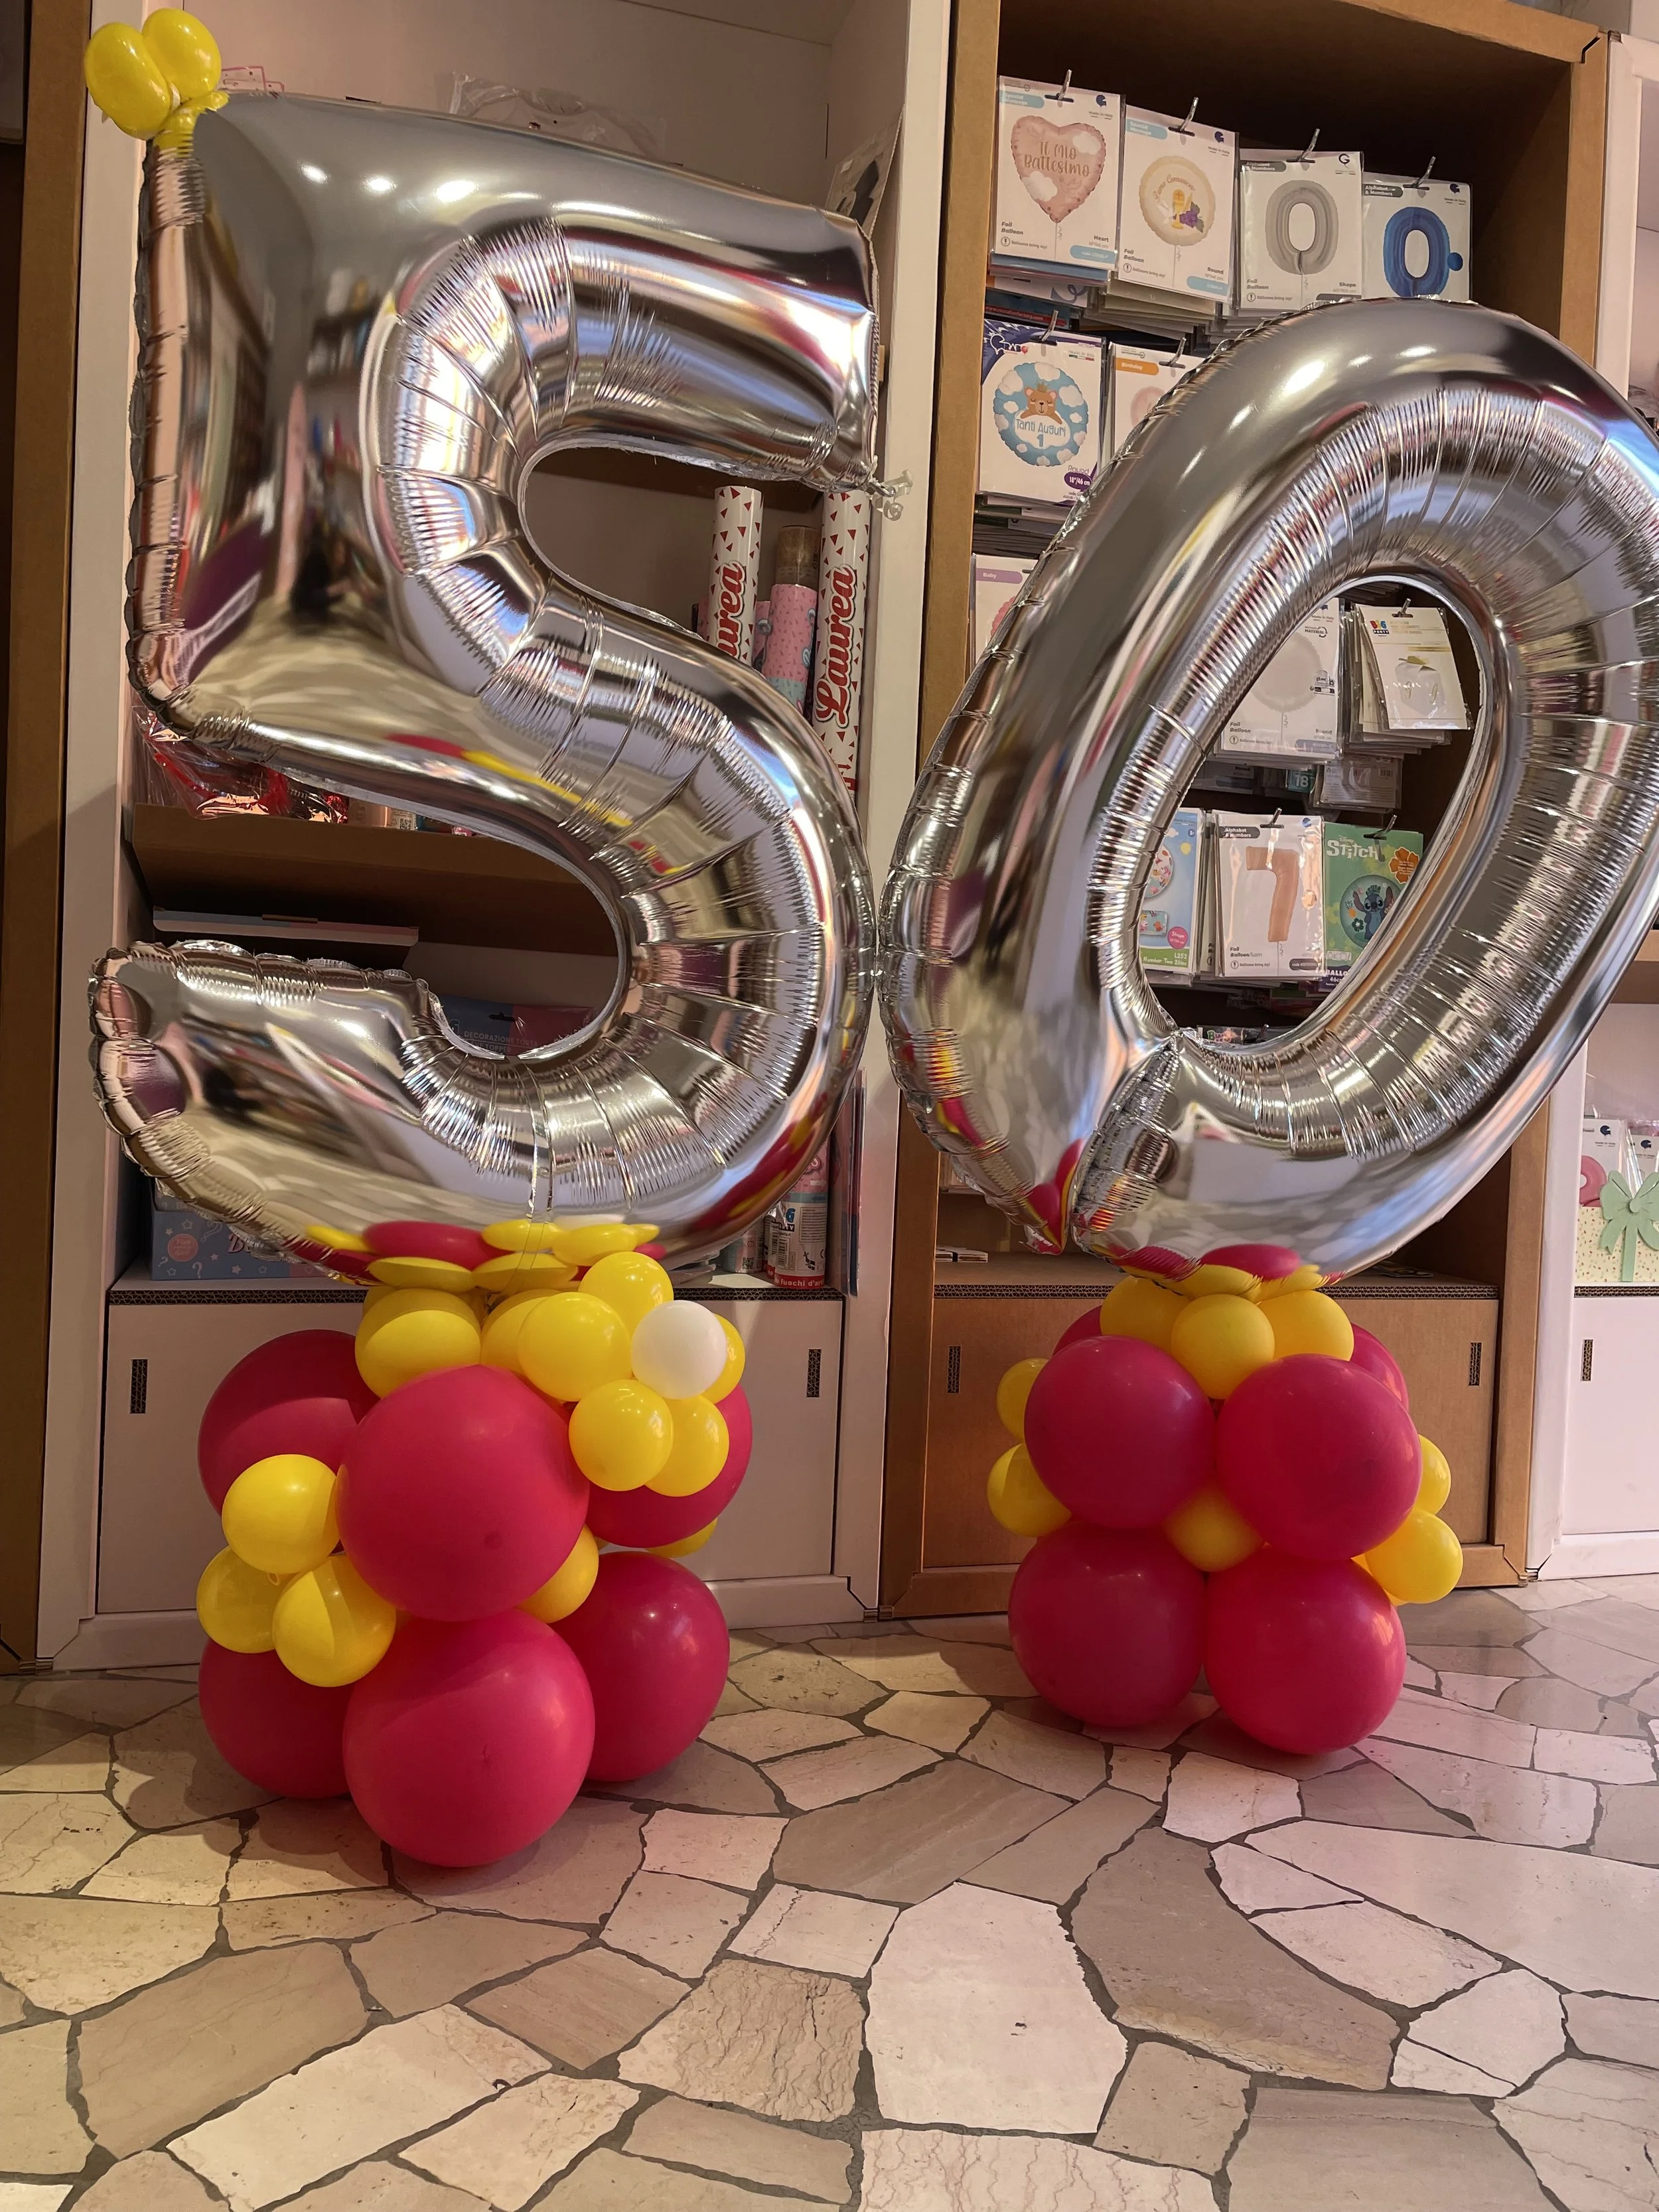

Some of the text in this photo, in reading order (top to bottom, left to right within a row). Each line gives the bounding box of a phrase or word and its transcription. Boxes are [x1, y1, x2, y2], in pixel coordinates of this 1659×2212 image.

[1054, 144, 1078, 160] Mio
[1024, 154, 1092, 177] Battesimo
[1207, 266, 1224, 275] Round
[1015, 419, 1066, 437] Tanti Auguri
[1037, 434, 1044, 447] 1
[816, 565, 855, 726] Laurea
[1295, 774, 1309, 788] 18
[464, 1030, 514, 1045] DECORAZIONE
[485, 1043, 512, 1053] TOPPER
[780, 1278, 805, 1287] fuochi
